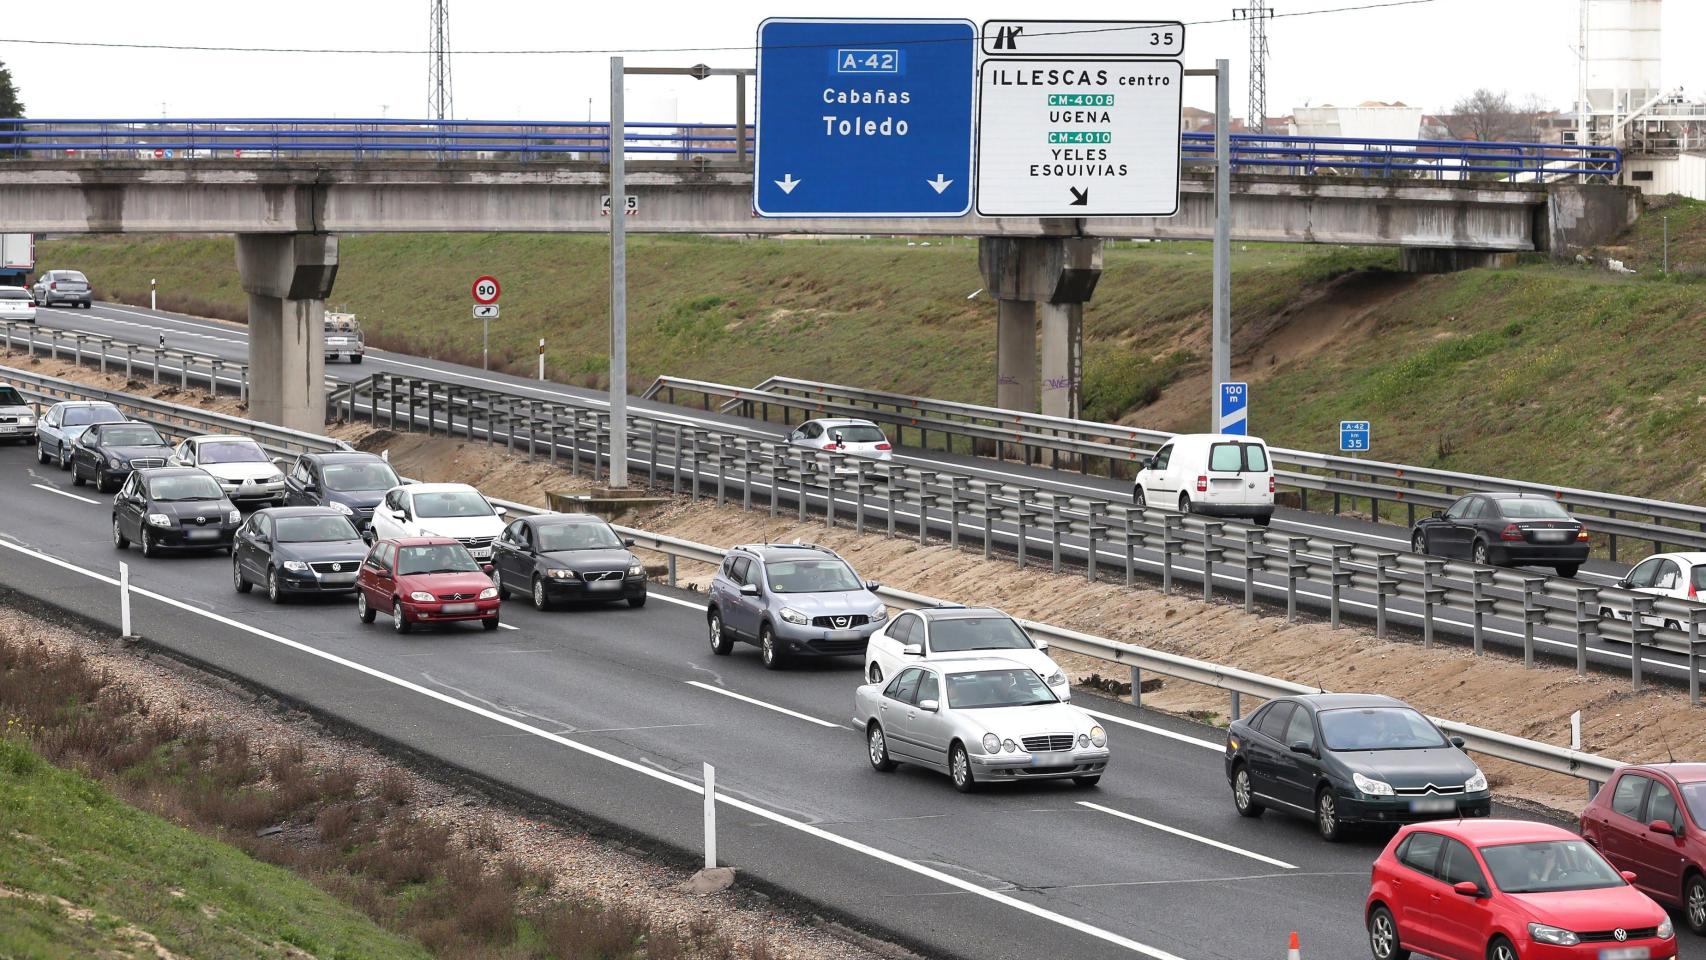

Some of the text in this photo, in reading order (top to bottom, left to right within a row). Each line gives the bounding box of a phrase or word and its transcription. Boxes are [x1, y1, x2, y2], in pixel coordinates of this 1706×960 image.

[1150, 33, 1174, 46] 35
[843, 54, 894, 69] A-42
[992, 70, 1170, 87] ILLESCAS centro
[823, 88, 911, 104] Cabañas
[1049, 95, 1113, 106] CM-4008
[1049, 111, 1111, 123] UGENA
[823, 116, 909, 136] Toledo
[1049, 133, 1110, 143] CM-4010
[1051, 149, 1108, 161] YELES
[1030, 164, 1128, 177] ESQUIVIAS
[479, 285, 495, 295] 90
[1226, 386, 1242, 395] 100
[1348, 440, 1362, 449] 35
